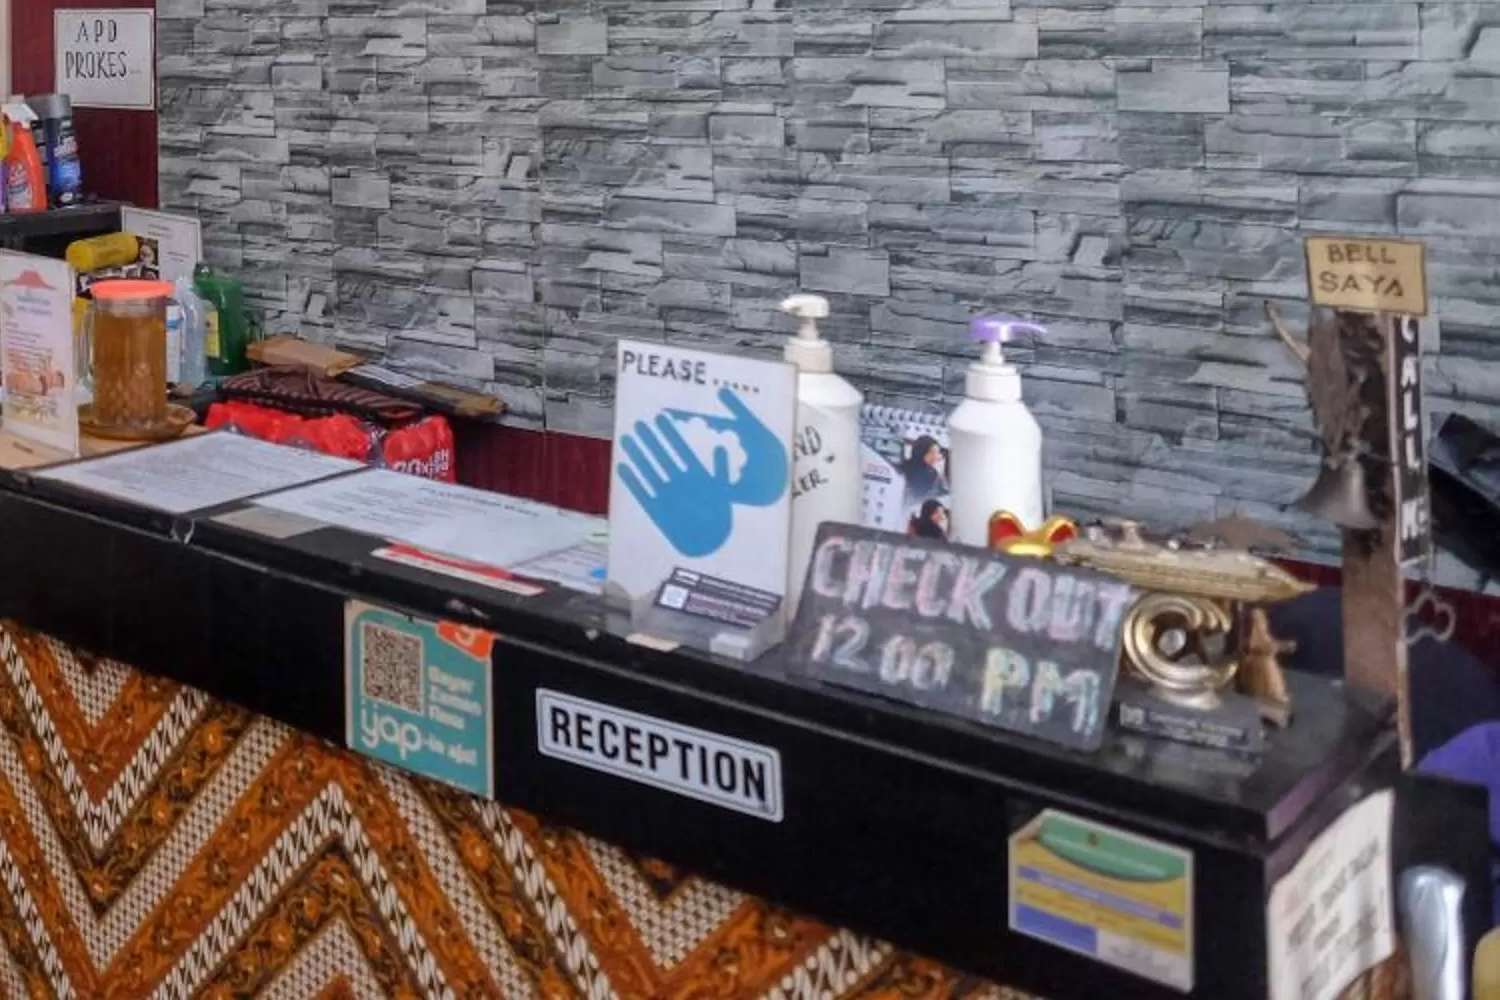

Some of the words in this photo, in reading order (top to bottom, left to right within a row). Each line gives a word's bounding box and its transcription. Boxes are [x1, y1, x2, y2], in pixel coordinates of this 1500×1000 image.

[65, 51, 127, 79] PROKES
[1327, 243, 1398, 265] BELL
[1317, 270, 1405, 298] SAYA
[811, 535, 1006, 632] CHECK
[1006, 567, 1140, 651] OUT
[981, 648, 1102, 737] PM
[550, 706, 767, 804] RECEPTION
